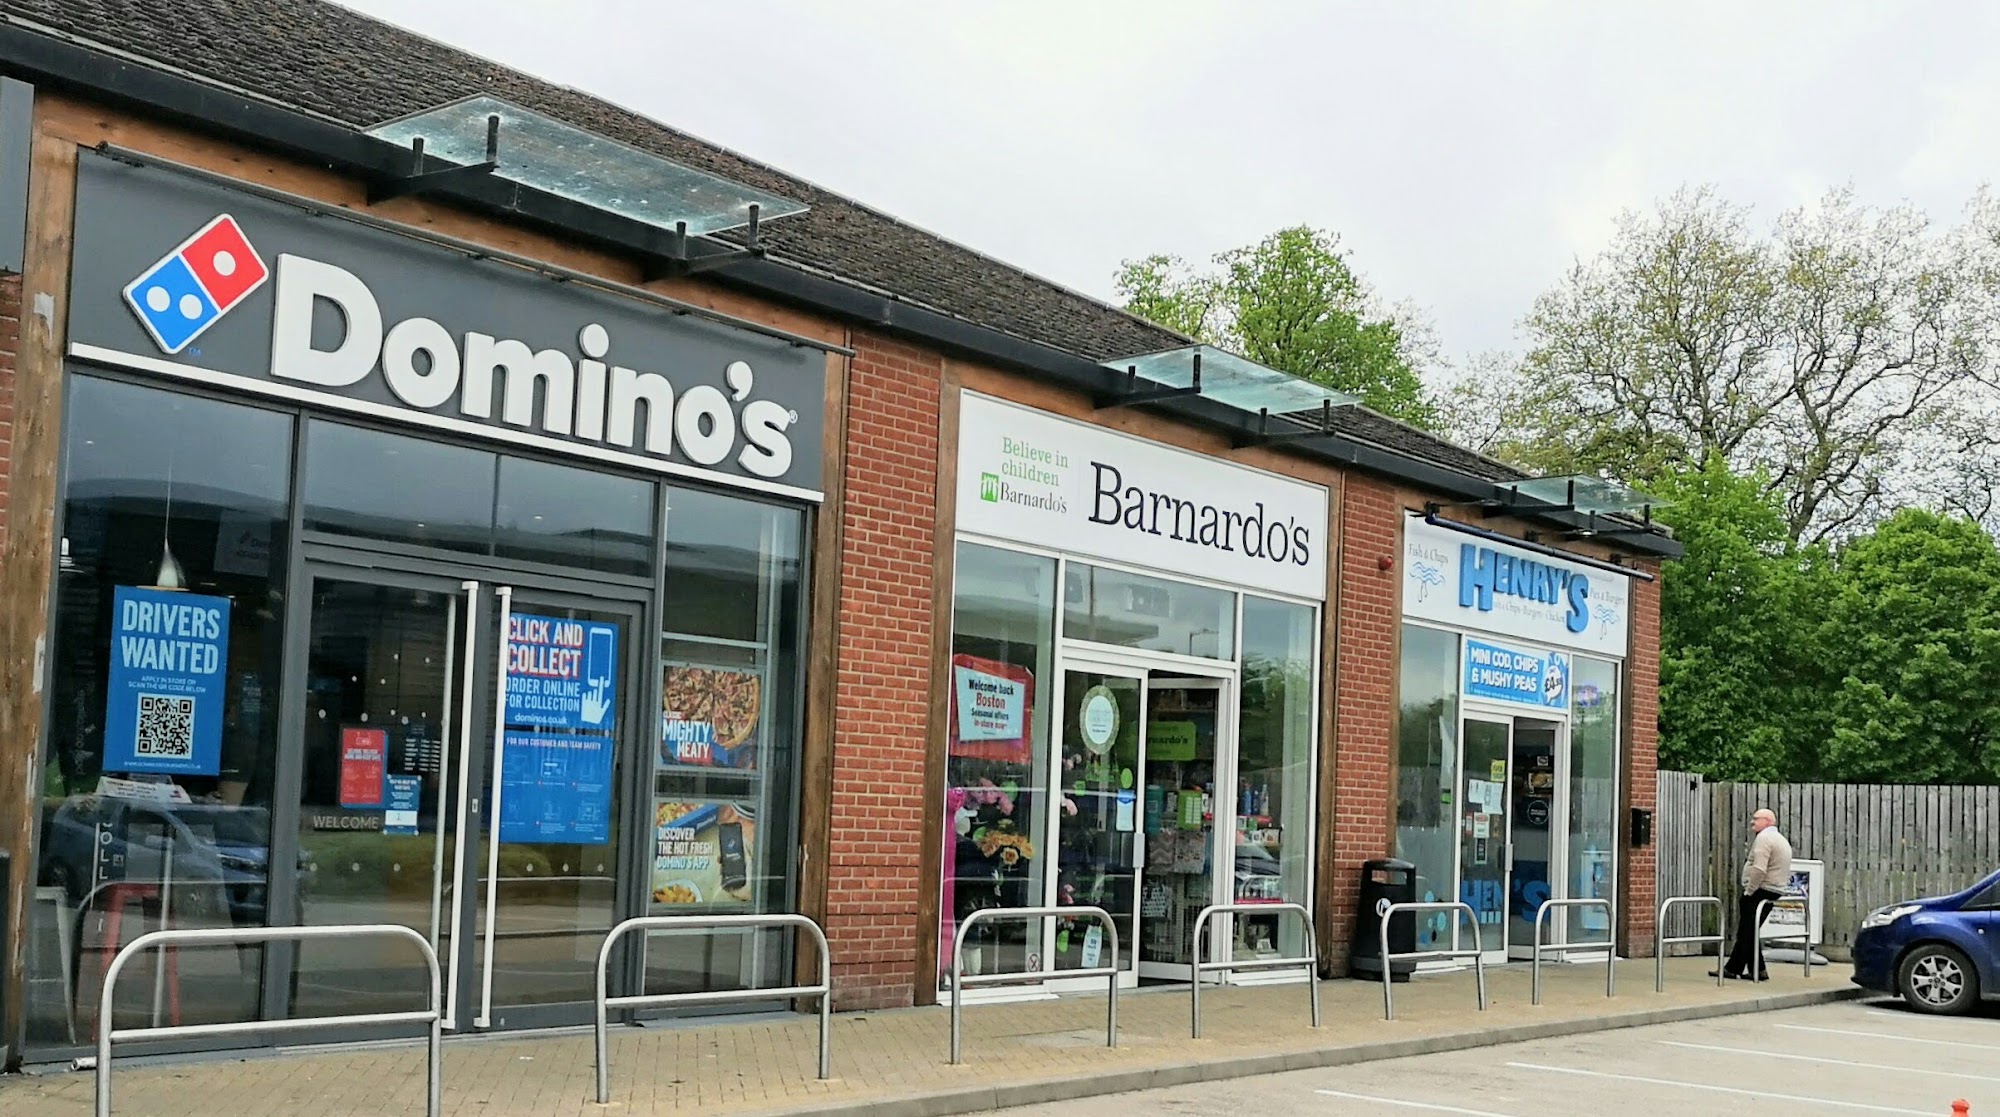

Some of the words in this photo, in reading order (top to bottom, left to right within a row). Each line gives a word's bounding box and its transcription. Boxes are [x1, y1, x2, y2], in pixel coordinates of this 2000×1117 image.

[271, 252, 793, 478] Domino's
[1002, 436, 1052, 464] Believe
[1055, 450, 1069, 468] in
[1001, 459, 1059, 486] children
[1000, 481, 1067, 514] Barnardo's
[1088, 461, 1310, 567] Barnardo's
[1459, 543, 1589, 633] HENRY'S
[122, 600, 220, 640] DRIVERS
[508, 616, 550, 643] CLICK
[553, 621, 583, 646] AND
[121, 636, 218, 674] WANTED
[507, 643, 581, 677] COLLECT
[1471, 647, 1490, 665] MINI
[1492, 651, 1512, 671] COD,
[1514, 655, 1539, 673] CHIPS
[506, 677, 540, 694] ORDER
[543, 679, 581, 697] ONLINE
[968, 679, 997, 693] Welcome
[999, 683, 1014, 695] back
[1472, 667, 1480, 683] &
[1481, 669, 1513, 688] MUSHY
[1514, 674, 1537, 692] PEAS
[505, 693, 522, 708] FOR
[525, 696, 580, 712] COLLECTION
[976, 692, 1005, 709] Boston
[971, 707, 993, 718] Seasonal
[994, 710, 1009, 721] offers
[662, 719, 711, 742] MIGHTY
[677, 742, 710, 758] MEATY
[313, 815, 379, 829] WELCOME
[658, 827, 695, 840] DISCOVER
[658, 841, 673, 855] THE
[674, 842, 690, 855] HOT
[690, 842, 713, 855] FRESH
[657, 855, 693, 870] DOMINO'S
[694, 857, 710, 870] APP
